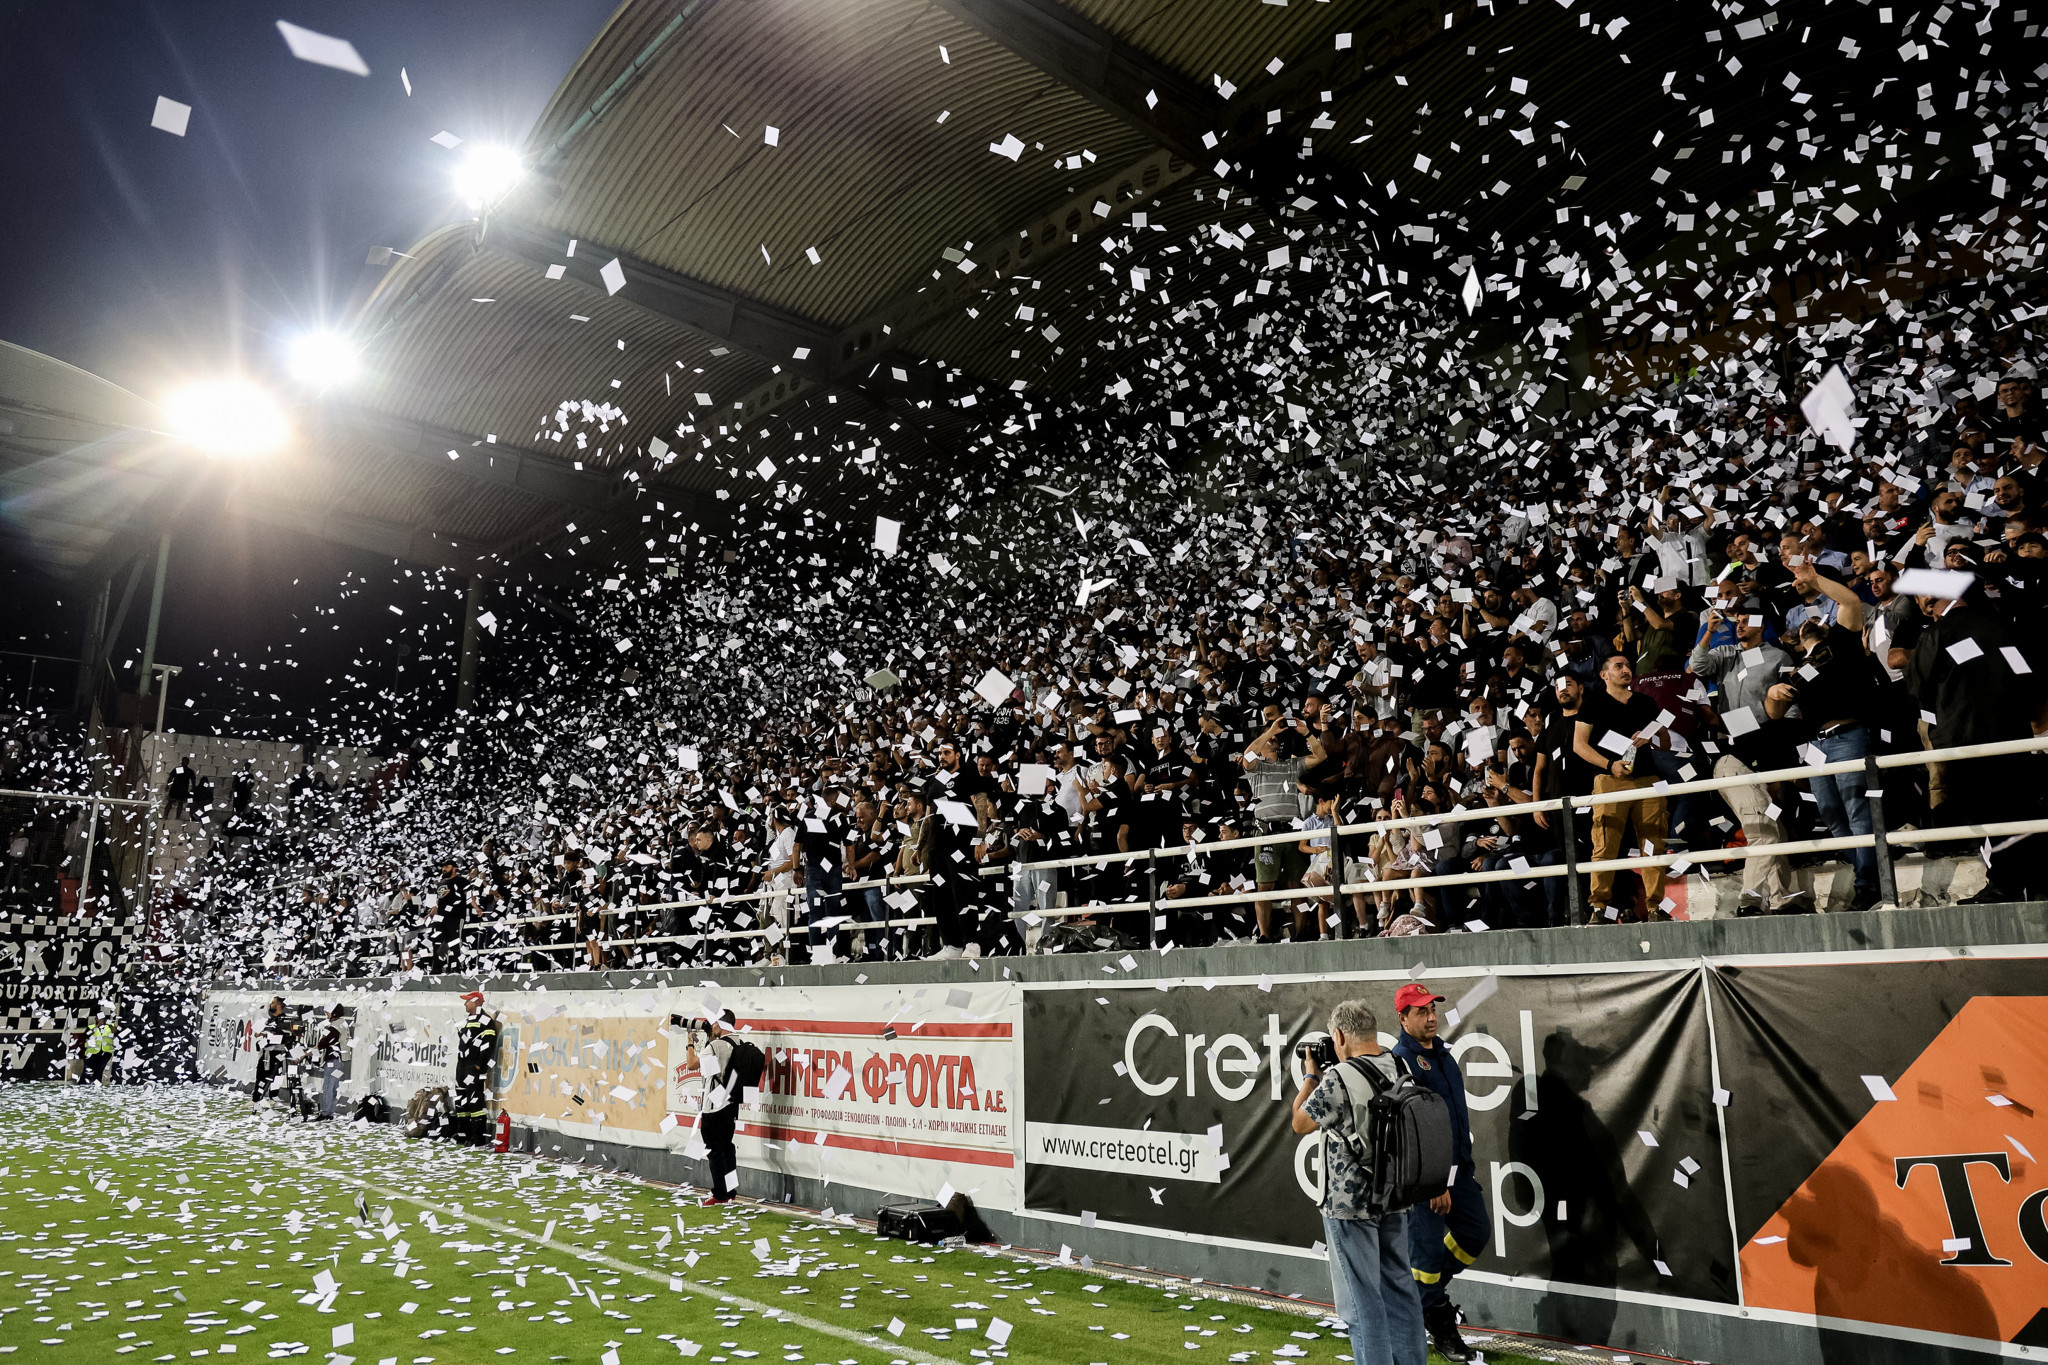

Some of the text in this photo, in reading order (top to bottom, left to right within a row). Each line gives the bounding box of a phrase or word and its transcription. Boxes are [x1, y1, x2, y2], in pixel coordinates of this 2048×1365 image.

[758, 1046, 1007, 1113] ΛΗΜΕΡΑ ΦΡΟΥΤΑ Α.Ε.
[1124, 1010, 1541, 1112] Cretel
[811, 1108, 843, 1121] ΤΡΟΦΟΔΟΣΙΑ
[844, 1111, 880, 1125] ΞΕΝΟΔΟΧΕΙΩΝ
[885, 1115, 907, 1128] ΠΛΟΙΩΝ
[928, 1120, 949, 1132] ΧΩΡΩΝ
[950, 1121, 977, 1135] ΜΑΖΙΚΗΣ
[978, 1123, 1007, 1137] ΕΣΤΙΑΣΗΣ
[1042, 1136, 1200, 1174] www.creteotel.gr
